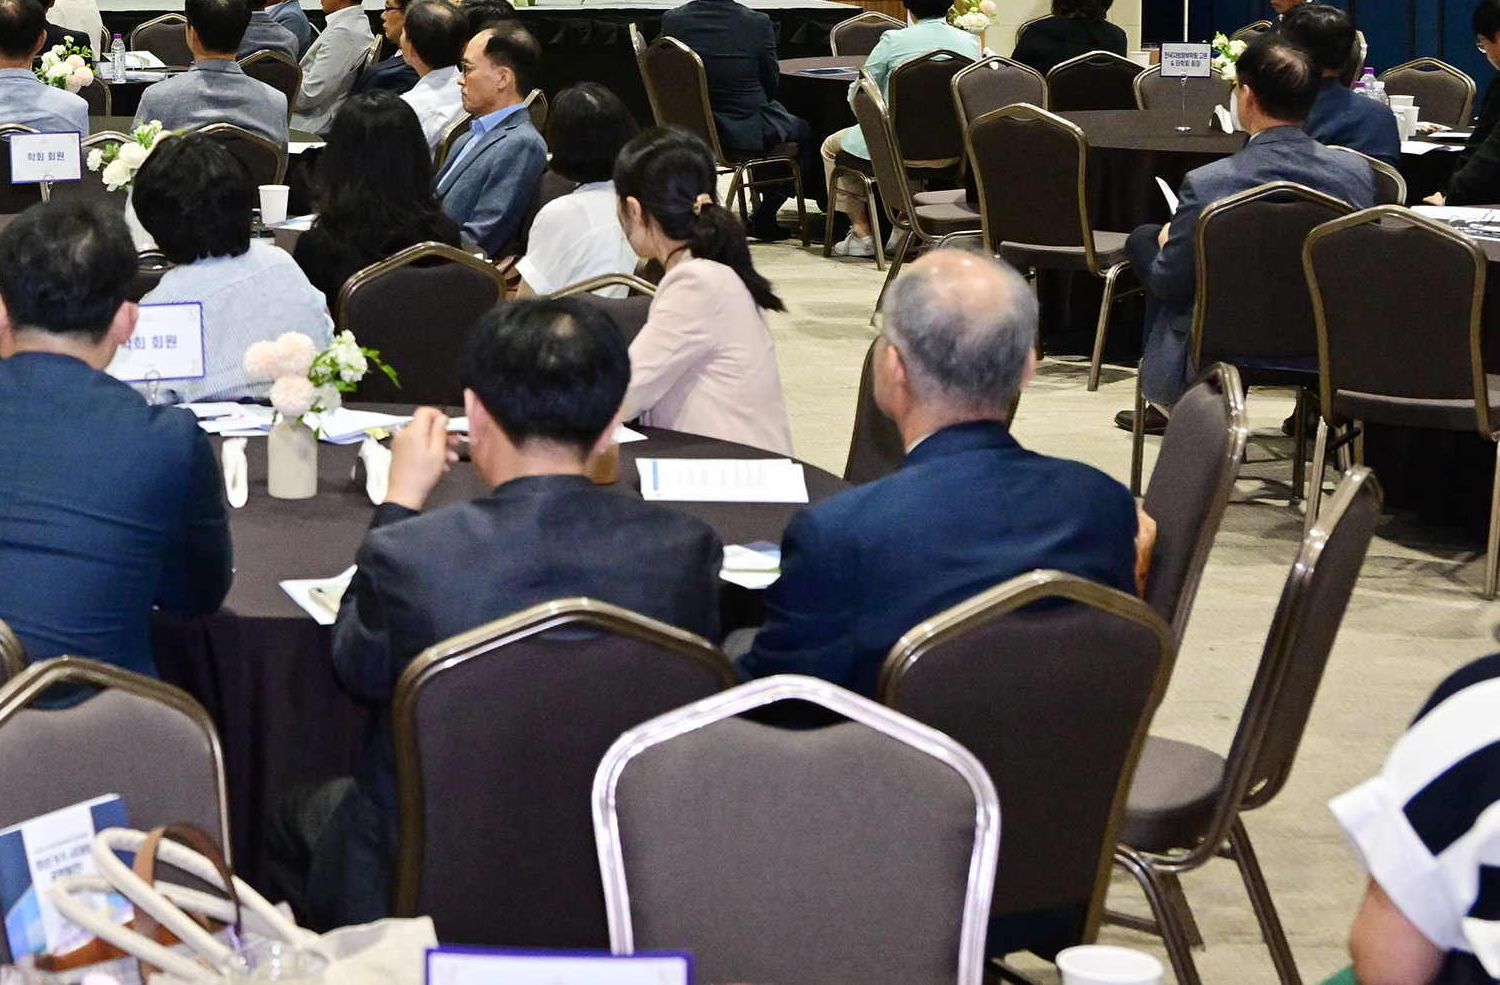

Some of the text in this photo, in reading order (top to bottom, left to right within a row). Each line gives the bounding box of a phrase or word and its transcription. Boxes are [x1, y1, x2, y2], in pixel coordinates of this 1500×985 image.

[26, 151, 65, 162] 학회 회원
[152, 334, 178, 350] 회원
